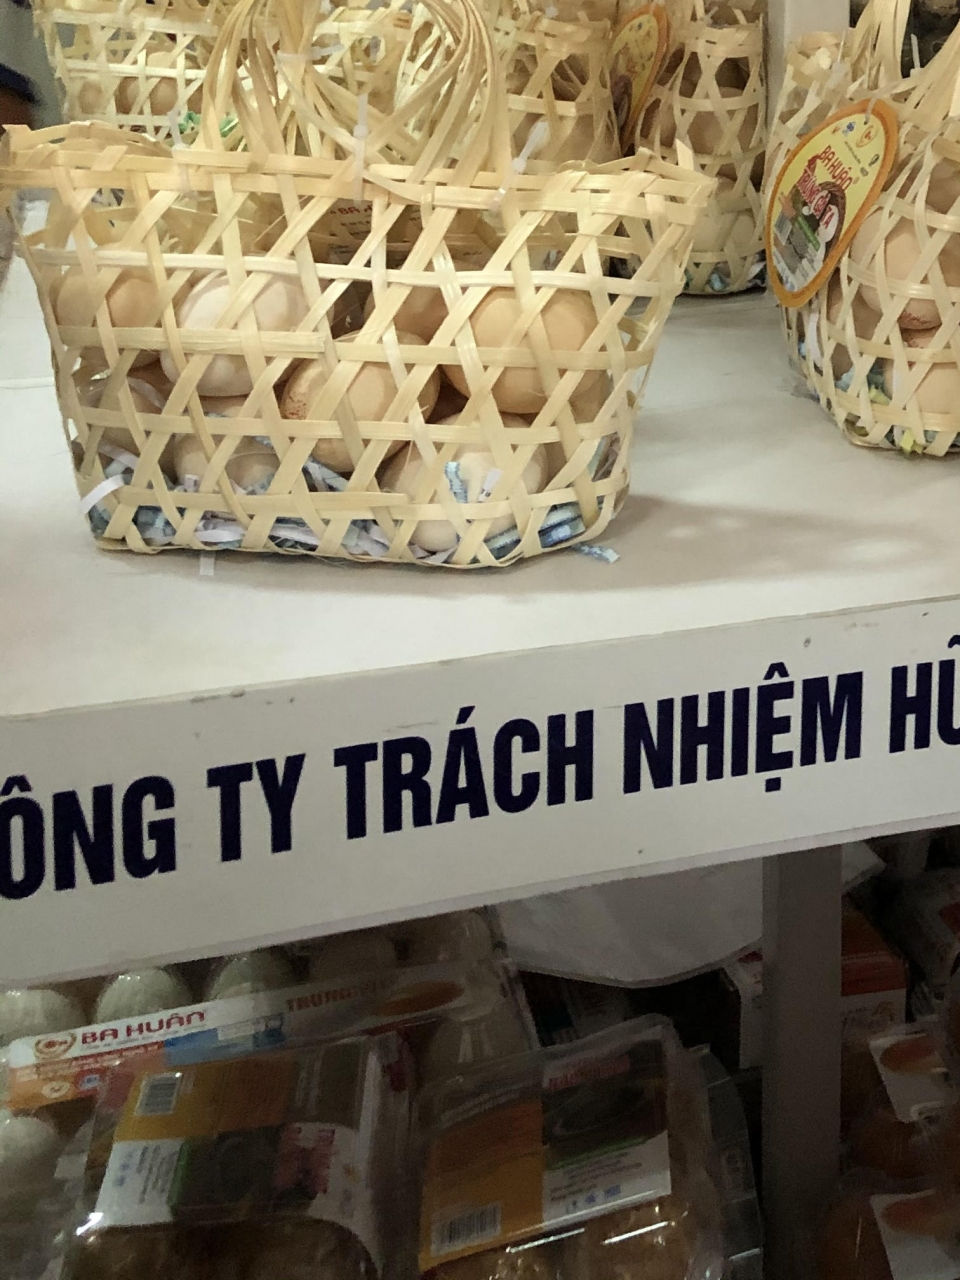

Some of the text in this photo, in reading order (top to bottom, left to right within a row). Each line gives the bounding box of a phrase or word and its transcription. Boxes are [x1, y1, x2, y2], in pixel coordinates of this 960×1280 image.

[206, 753, 306, 862] TY
[333, 705, 595, 840] TRÁCH
[623, 661, 863, 794] NHIỆM
[81, 1028, 119, 1045] BA
[126, 1010, 206, 1037] HUÂN
